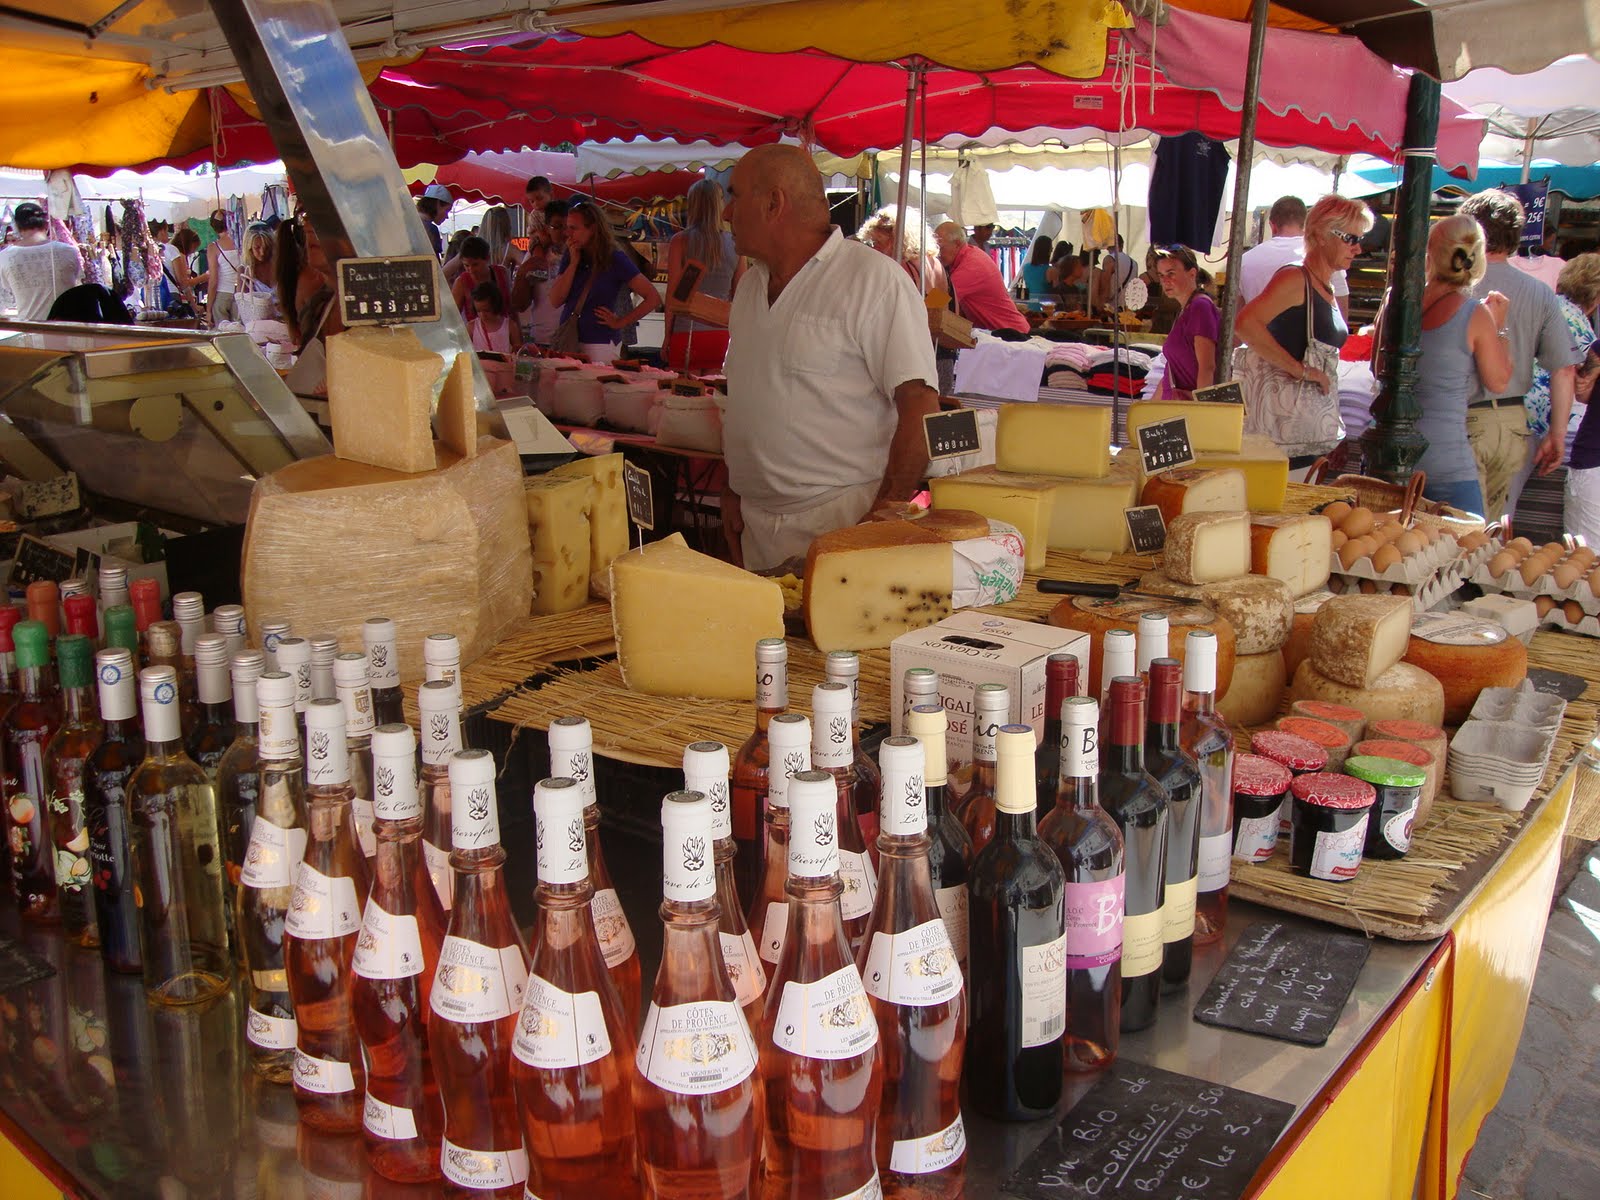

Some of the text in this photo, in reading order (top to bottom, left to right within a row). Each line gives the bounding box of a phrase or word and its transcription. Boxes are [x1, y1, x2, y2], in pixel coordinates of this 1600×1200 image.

[1533, 197, 1545, 208] 9€
[1527, 211, 1543, 223] 25€
[921, 640, 1001, 660] LE CIGALON
[1032, 702, 1043, 719] LE
[900, 813, 919, 824] La
[564, 859, 582, 871] La
[686, 877, 700, 888] de
[1096, 891, 1124, 936] Bi
[909, 941, 920, 950] DE
[1273, 967, 1305, 994] 10,50
[1314, 971, 1332, 981] €
[824, 990, 835, 1000] DE
[1202, 978, 1240, 1018] Domaine
[1304, 984, 1325, 1000] 12
[686, 1007, 714, 1019] CÔTES
[672, 1014, 728, 1029] DE PROVENCE
[1038, 1157, 1080, 1187] Vin
[1120, 1077, 1150, 1094] de
[1134, 1087, 1224, 1191] Bouteille 5,50
[1085, 1103, 1170, 1195] CORRENS
[1198, 1145, 1236, 1167] les
